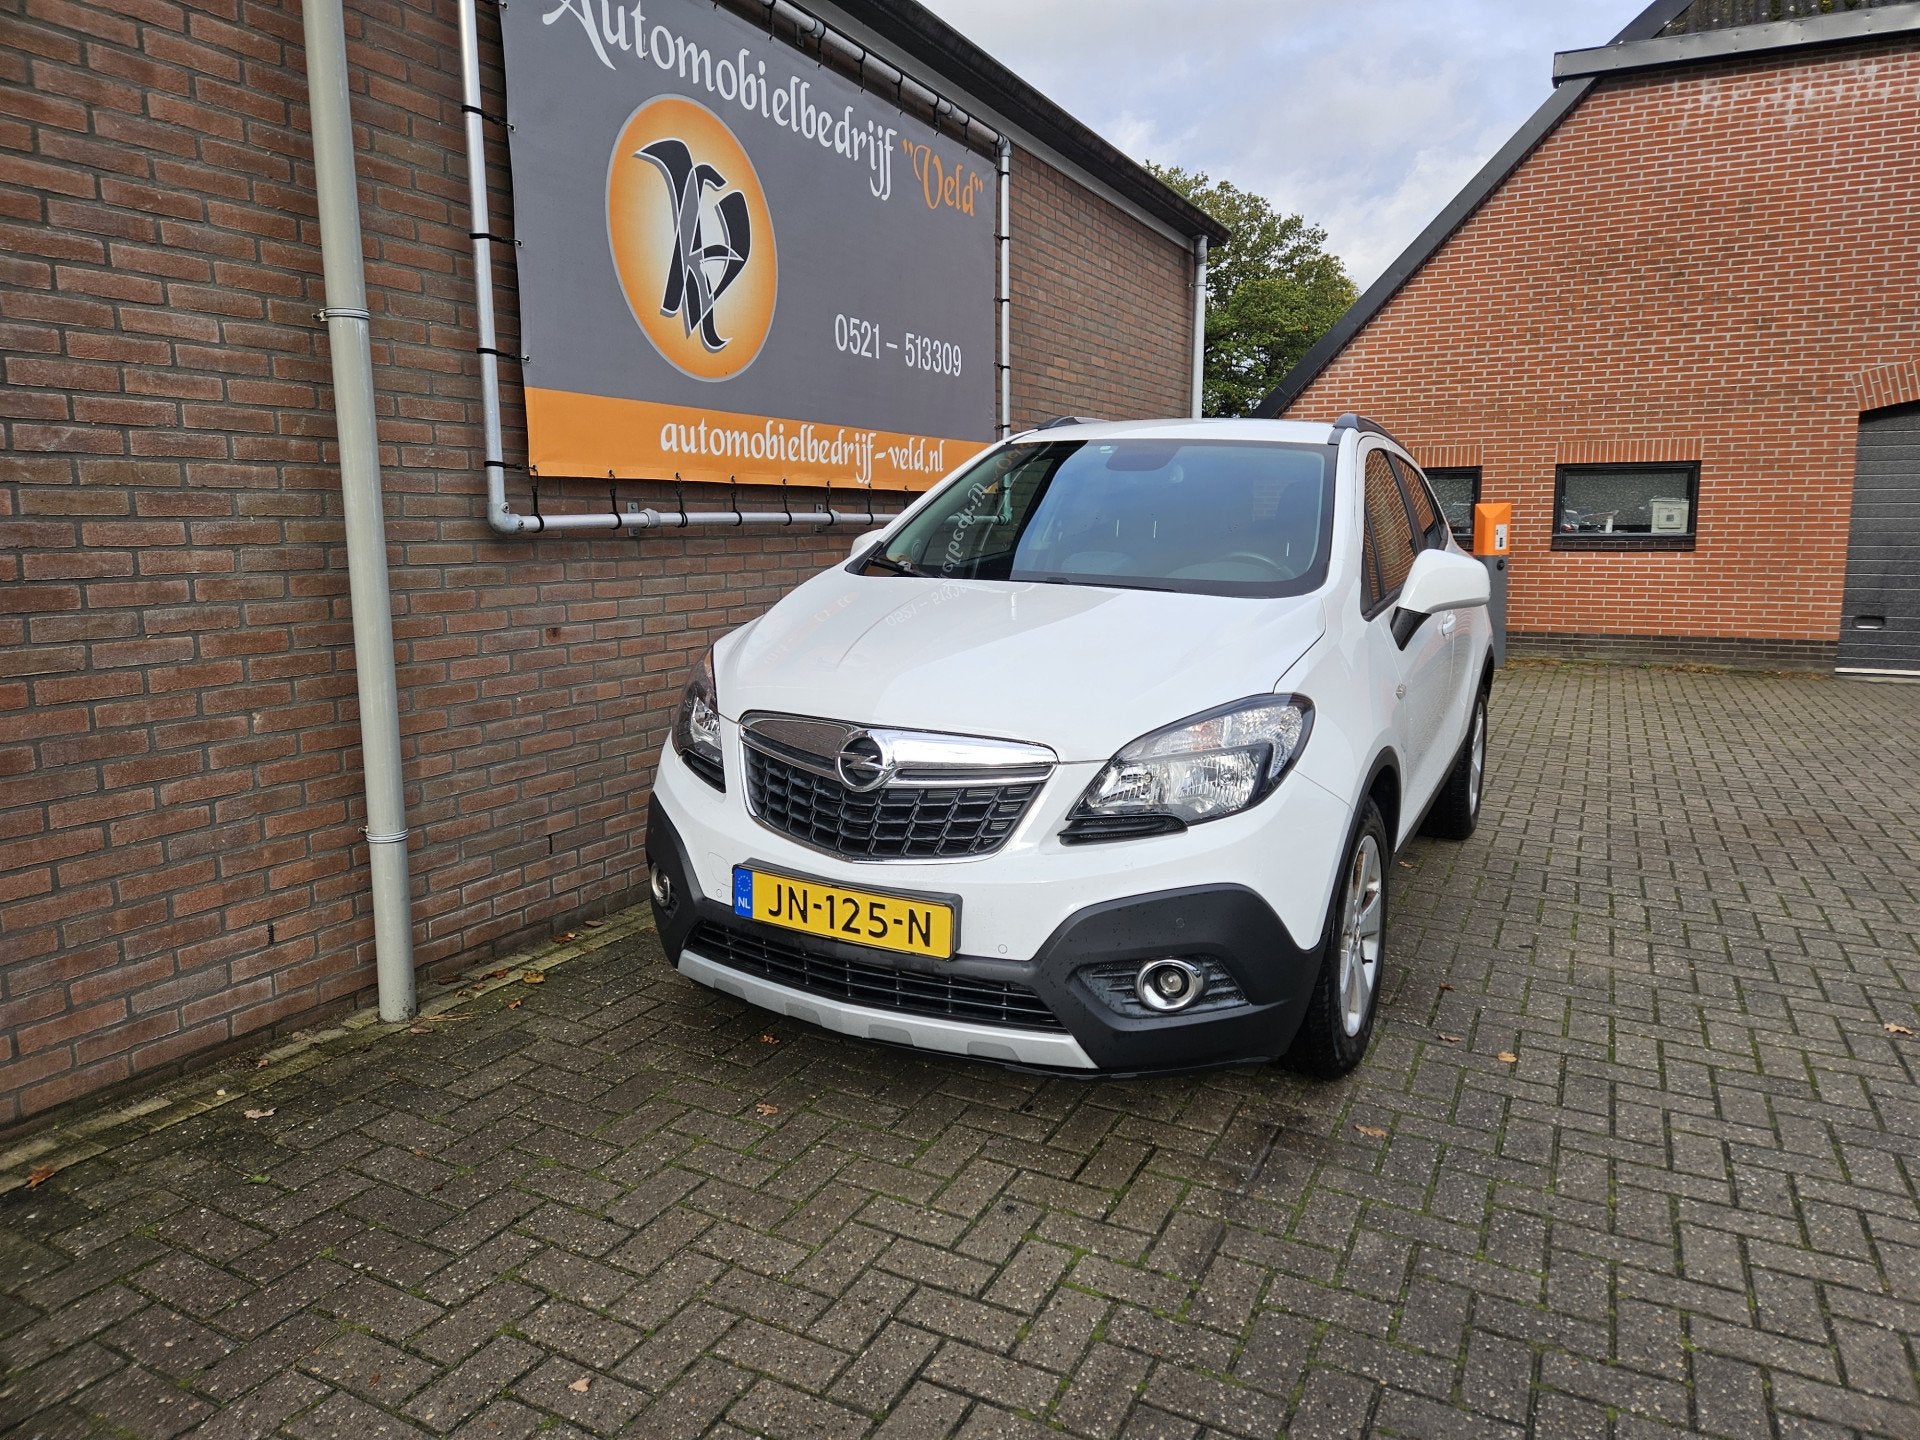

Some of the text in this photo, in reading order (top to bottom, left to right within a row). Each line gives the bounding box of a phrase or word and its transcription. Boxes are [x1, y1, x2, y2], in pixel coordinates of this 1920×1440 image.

[542, 0, 897, 201] Automobielbedrijf
[835, 313, 880, 359] 0521
[905, 332, 961, 377] 513309
[660, 417, 945, 485] automobielbedrijf-veld.nl
[738, 896, 751, 909] NL
[768, 883, 931, 948] JN-125-N
